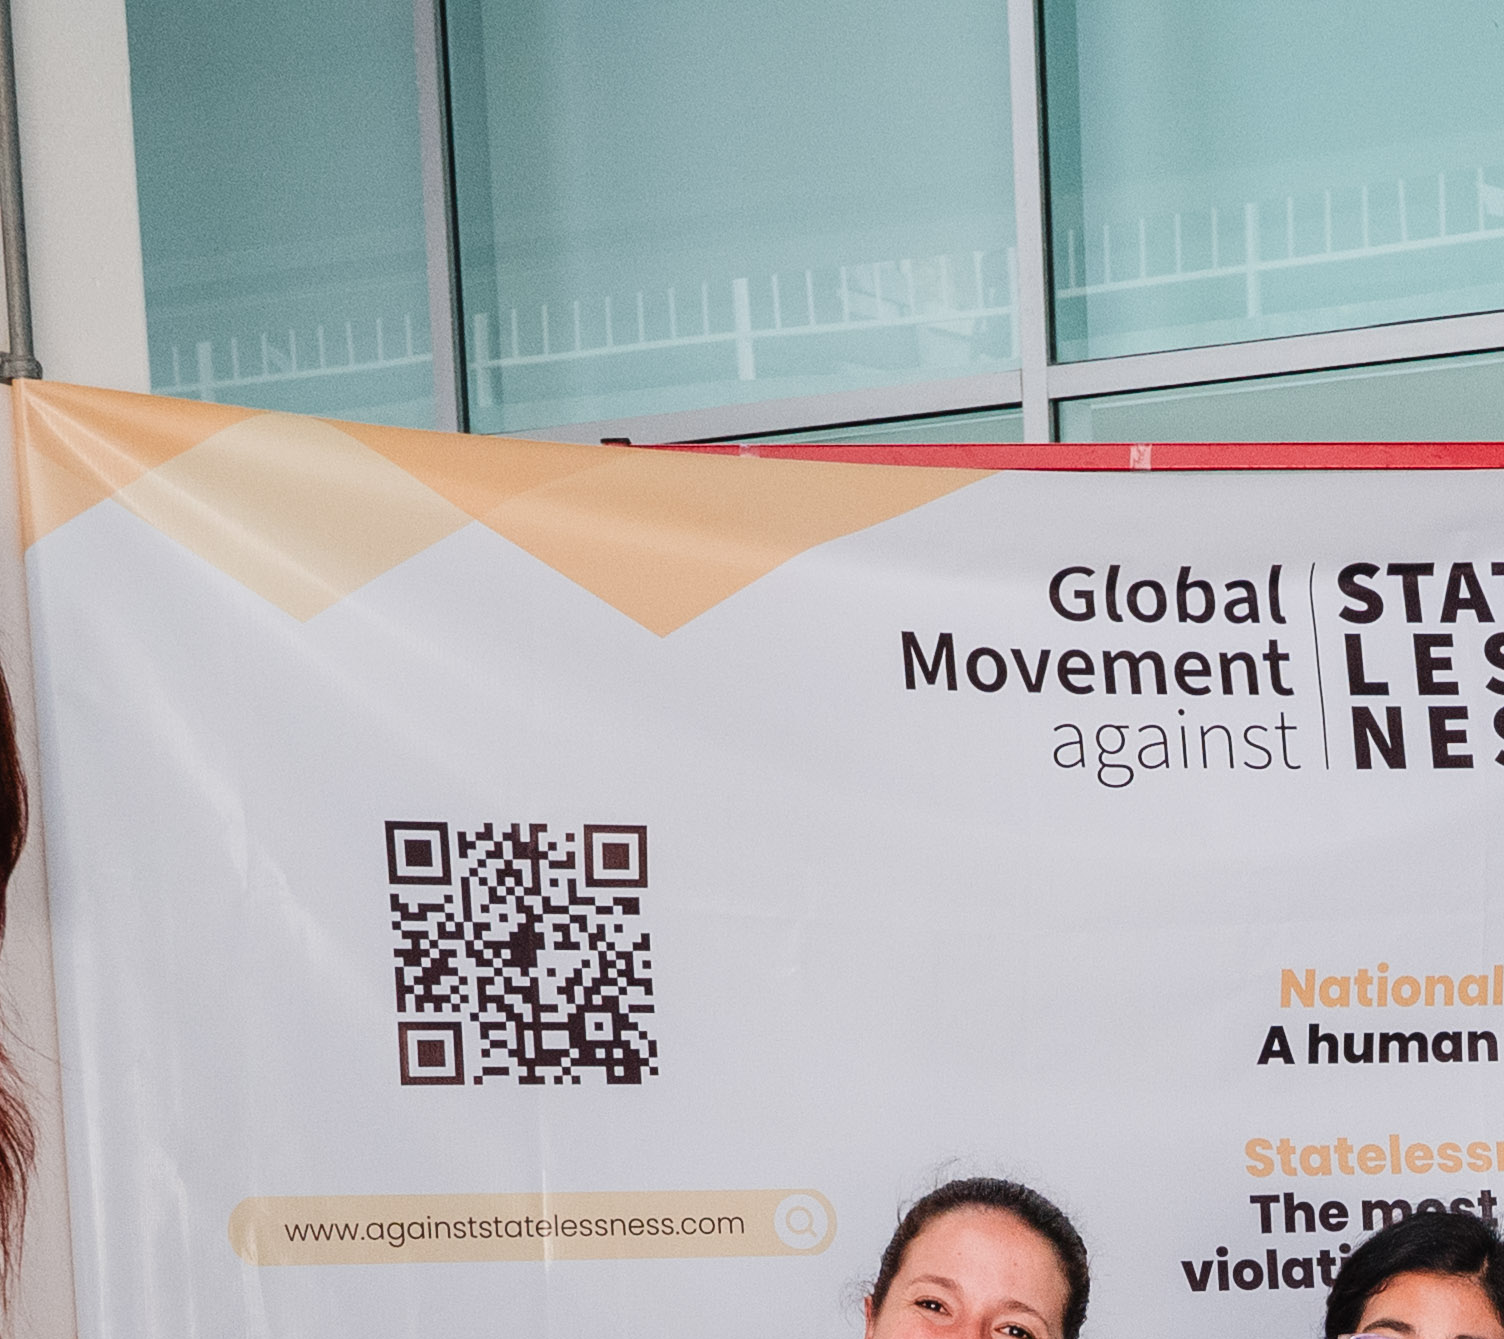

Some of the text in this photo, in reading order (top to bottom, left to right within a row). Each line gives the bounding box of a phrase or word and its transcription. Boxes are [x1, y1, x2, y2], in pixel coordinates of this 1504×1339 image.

[1049, 565, 1286, 624] Global
[902, 631, 1294, 698] Movement
[1052, 710, 1301, 789] against
[1256, 1025, 1295, 1065] A
[1308, 1023, 1497, 1065] human
[284, 1213, 745, 1246] www.againststatelessness.com
[1249, 1192, 1349, 1234] The
[1181, 1246, 1352, 1292] violati
